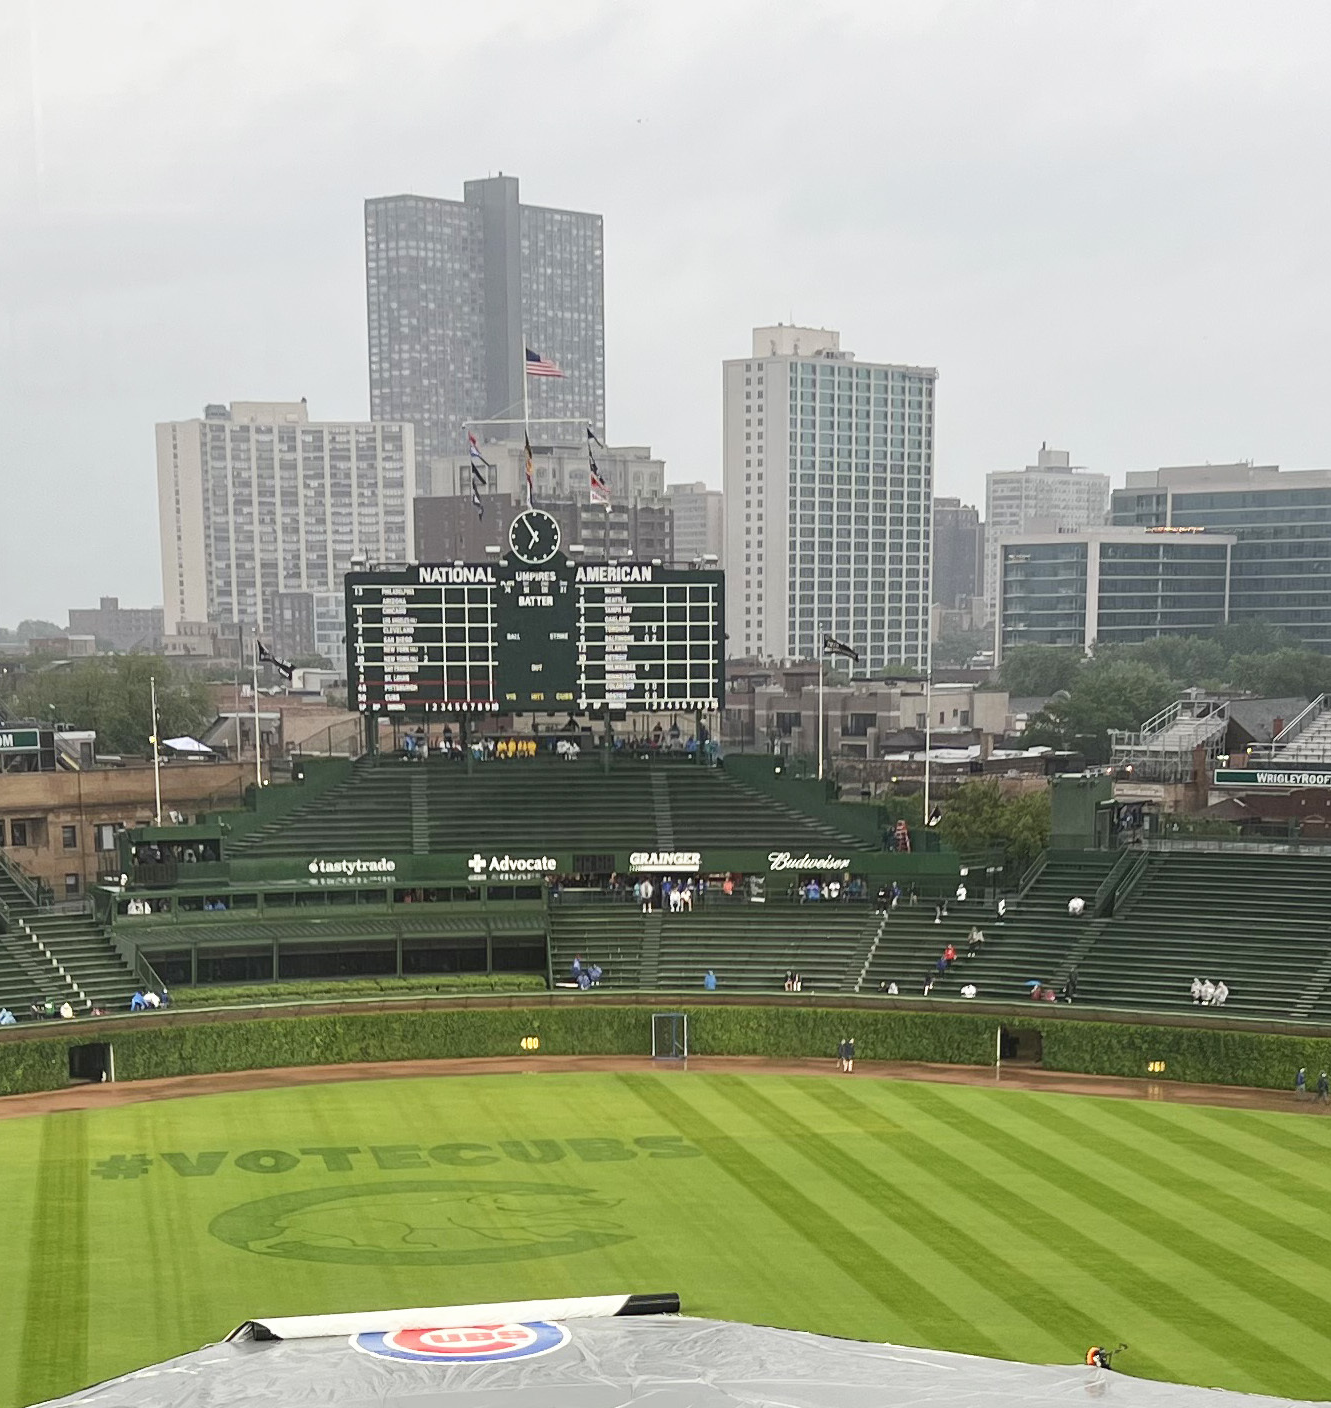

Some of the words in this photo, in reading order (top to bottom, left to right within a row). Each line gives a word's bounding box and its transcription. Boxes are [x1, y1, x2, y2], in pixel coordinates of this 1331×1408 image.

[419, 567, 496, 583] NATIONAL
[515, 571, 556, 581] UMPIRES
[575, 566, 652, 582] AMERICAN
[518, 595, 553, 606] BATTER
[319, 858, 396, 875] tastytrade
[489, 855, 557, 871] Advocate
[629, 852, 701, 866] GRAINGER
[767, 851, 851, 871] Budweiser
[520, 1036, 540, 1050] 400
[91, 1134, 704, 1181] #VOTECUBS
